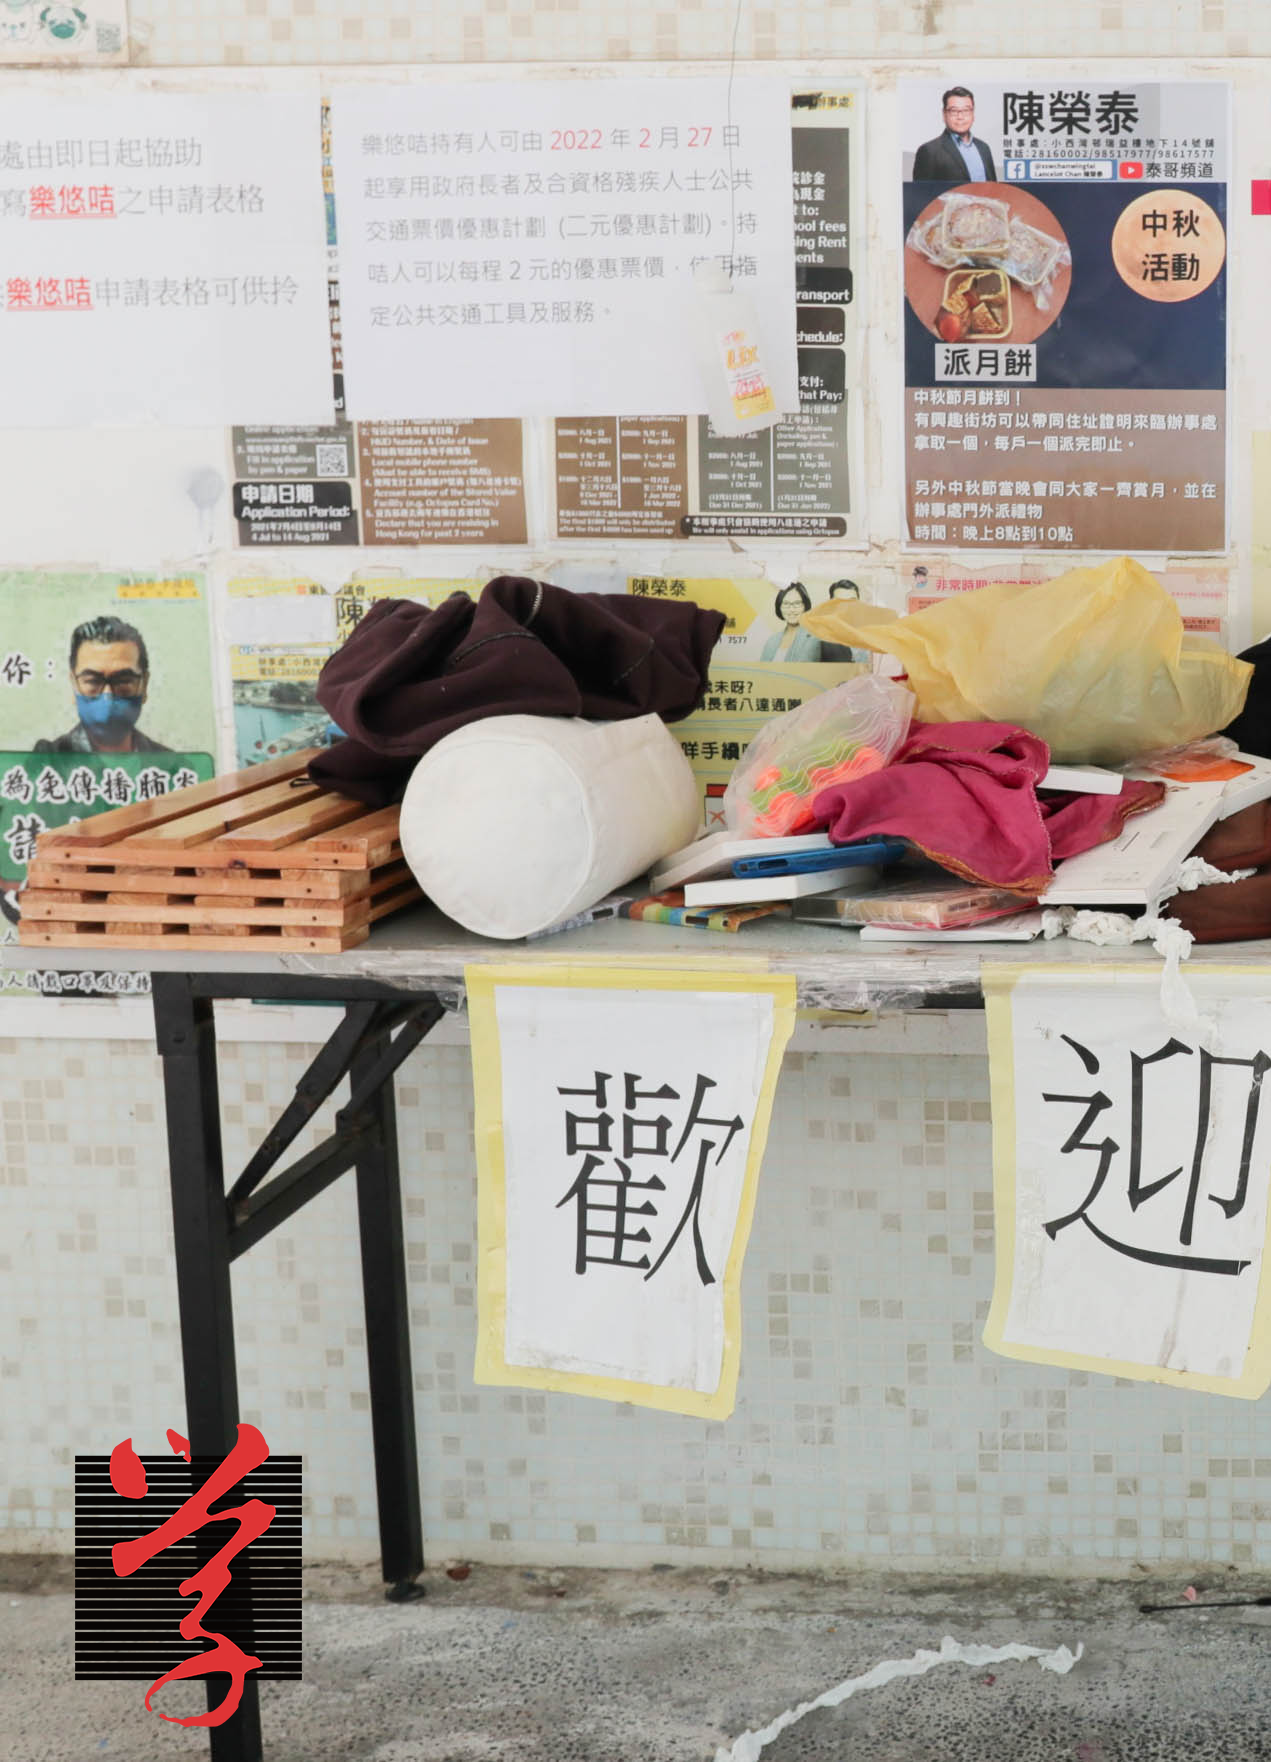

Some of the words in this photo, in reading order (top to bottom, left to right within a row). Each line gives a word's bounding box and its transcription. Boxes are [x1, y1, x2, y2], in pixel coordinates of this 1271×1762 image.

[1003, 91, 1139, 135] 陳榮泰
[361, 131, 543, 156] 樂悠咭持有人可由
[550, 130, 602, 150] 2022
[611, 128, 631, 151] 年
[638, 128, 650, 149] 2
[658, 126, 680, 150] 月
[687, 127, 712, 147] 27
[721, 125, 741, 149] 日
[1146, 162, 1214, 179] 泰哥頻道
[1, 184, 265, 219] 寫樂悠咭之申請表格
[366, 216, 546, 243] 交通票價優惠計劃
[819, 220, 847, 233] fees
[1142, 209, 1201, 238] 中秋
[817, 236, 847, 251] Rent
[796, 252, 825, 264] ents
[368, 259, 503, 284] 咭人可以每程
[509, 259, 522, 280] 2
[1142, 253, 1201, 283] 活動
[0, 275, 299, 307] 樂悠咭申請表格可供拎
[796, 290, 850, 303] ransport
[370, 302, 611, 328] 定公共交通工具及服務。
[796, 331, 843, 344] chedule:
[944, 348, 1033, 377] 派月餅
[819, 389, 843, 401] Pay:
[914, 389, 1021, 406] 中秋節月餅到！
[241, 484, 315, 503] 申請日期
[241, 506, 308, 520] Application
[308, 506, 351, 517] Period:
[914, 503, 1043, 519] 辦事處門外派禮物
[914, 525, 1074, 543] 時間：晚上8點到10點
[632, 579, 687, 597] 陳榮泰
[727, 636, 748, 645] 7577
[3, 767, 197, 804] 為免傳播肺炎
[556, 1070, 745, 1287] 歡
